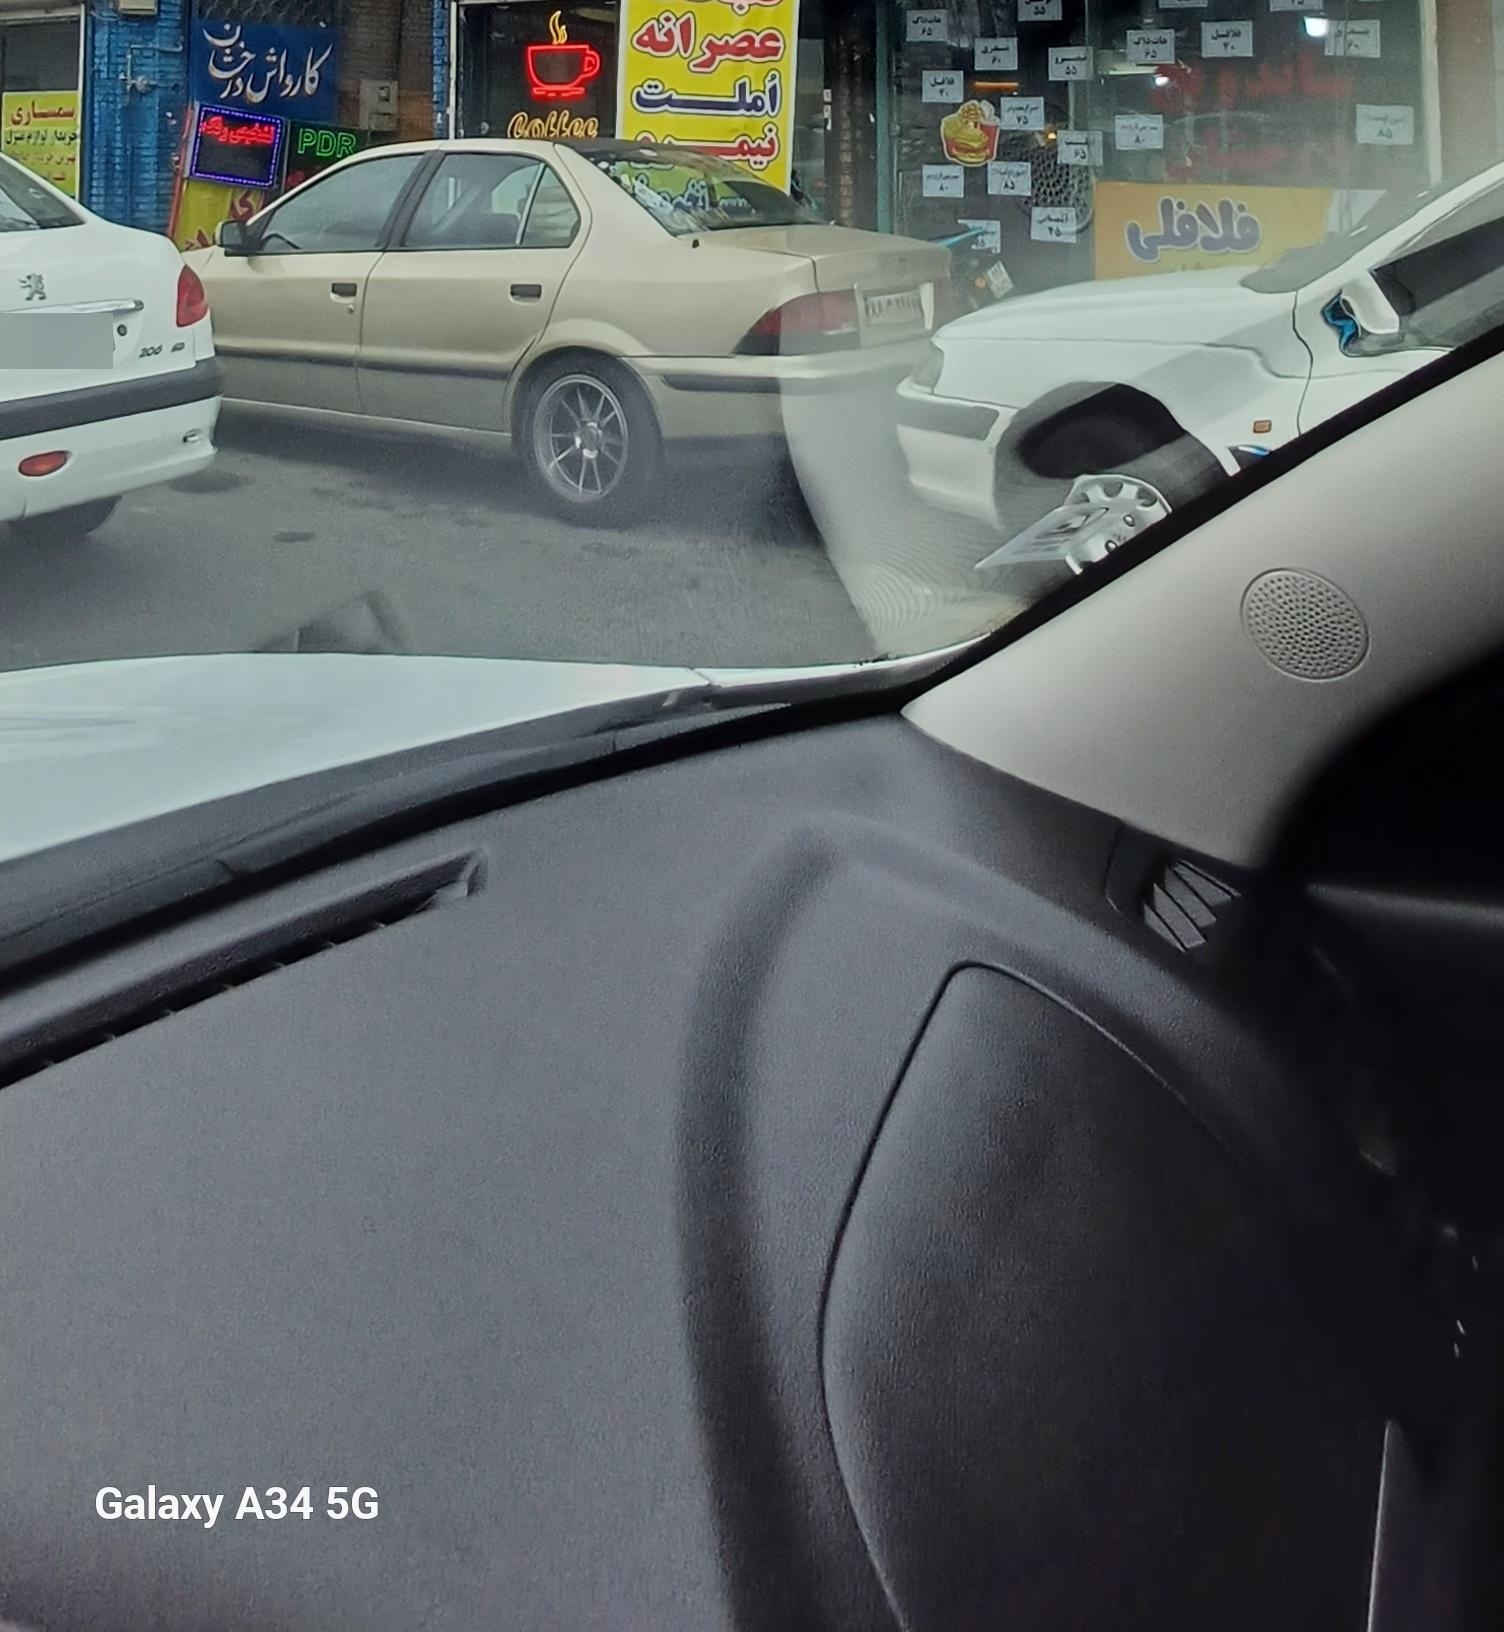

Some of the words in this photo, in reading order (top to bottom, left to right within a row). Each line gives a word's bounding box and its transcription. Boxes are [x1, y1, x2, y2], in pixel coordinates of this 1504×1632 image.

[632, 11, 785, 73] عصرانه
[297, 126, 357, 159] PDR
[506, 109, 600, 139] Coffee
[1126, 196, 1262, 265] فلافلی
